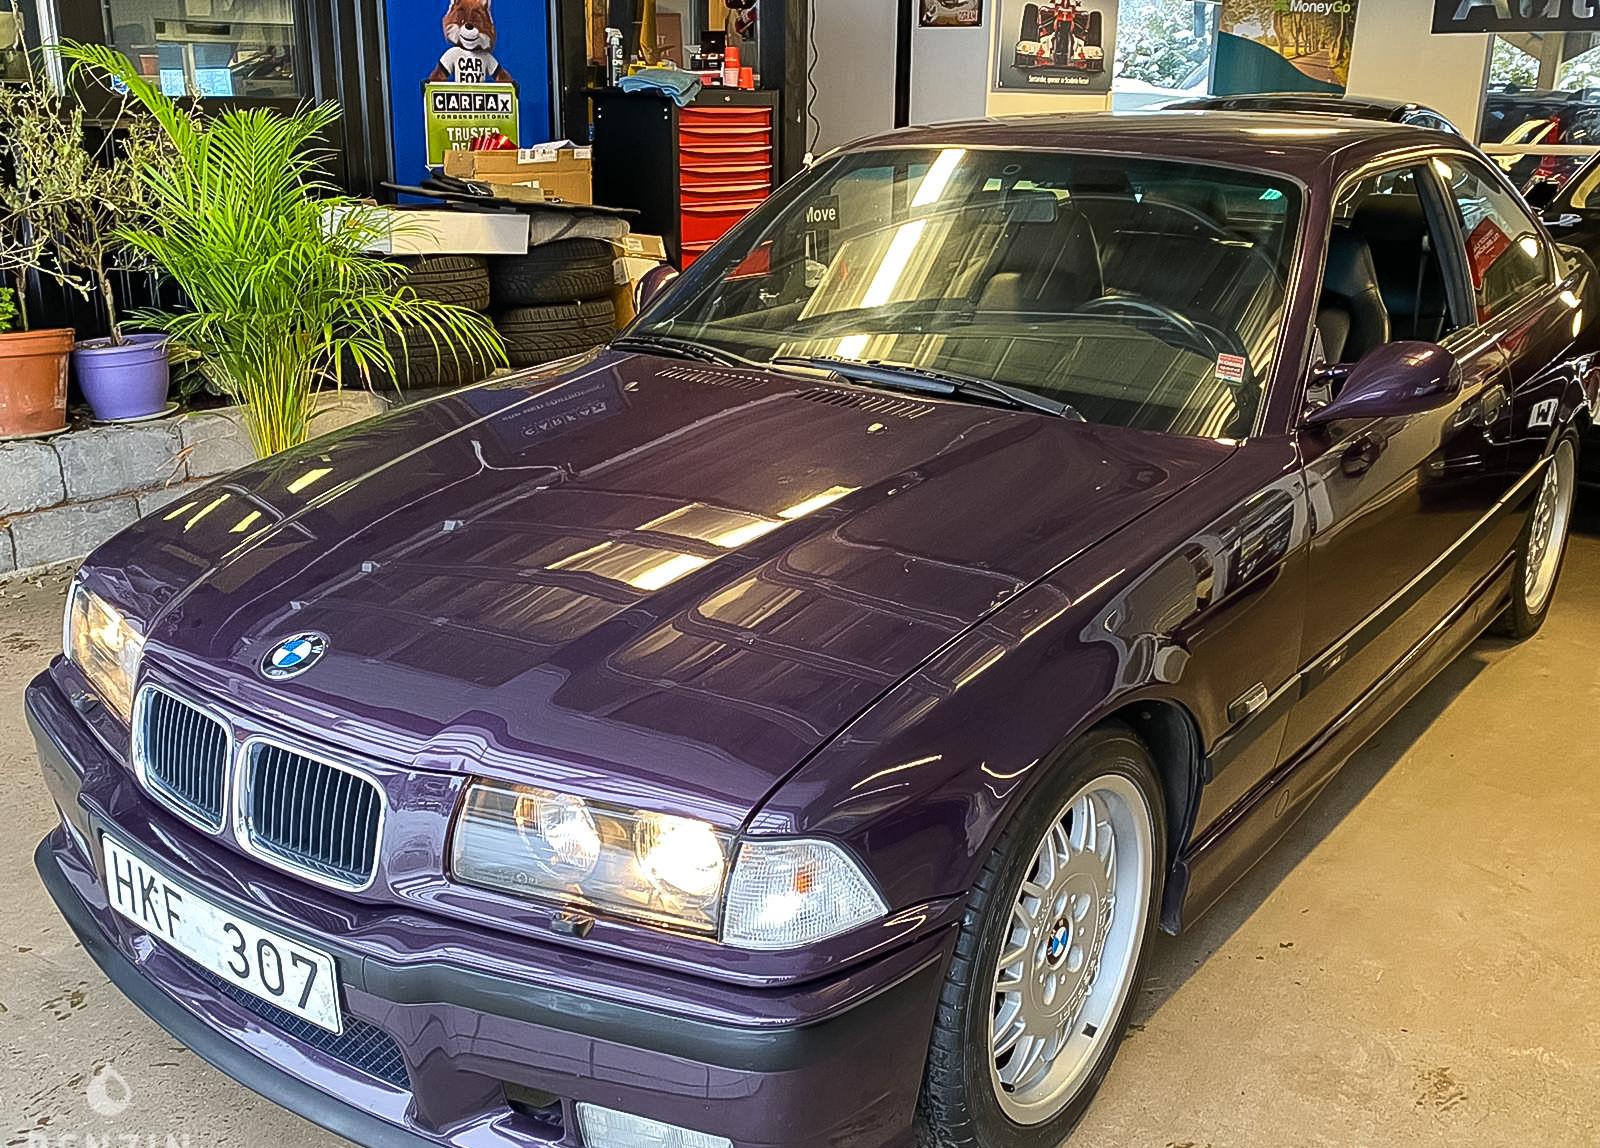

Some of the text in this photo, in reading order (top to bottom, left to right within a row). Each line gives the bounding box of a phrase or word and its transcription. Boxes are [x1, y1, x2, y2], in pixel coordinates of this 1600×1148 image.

[1290, 0, 1351, 16] MoneyGo
[458, 57, 482, 72] CAR
[435, 95, 510, 112] CARFAX
[113, 851, 318, 1009] HKF 307
